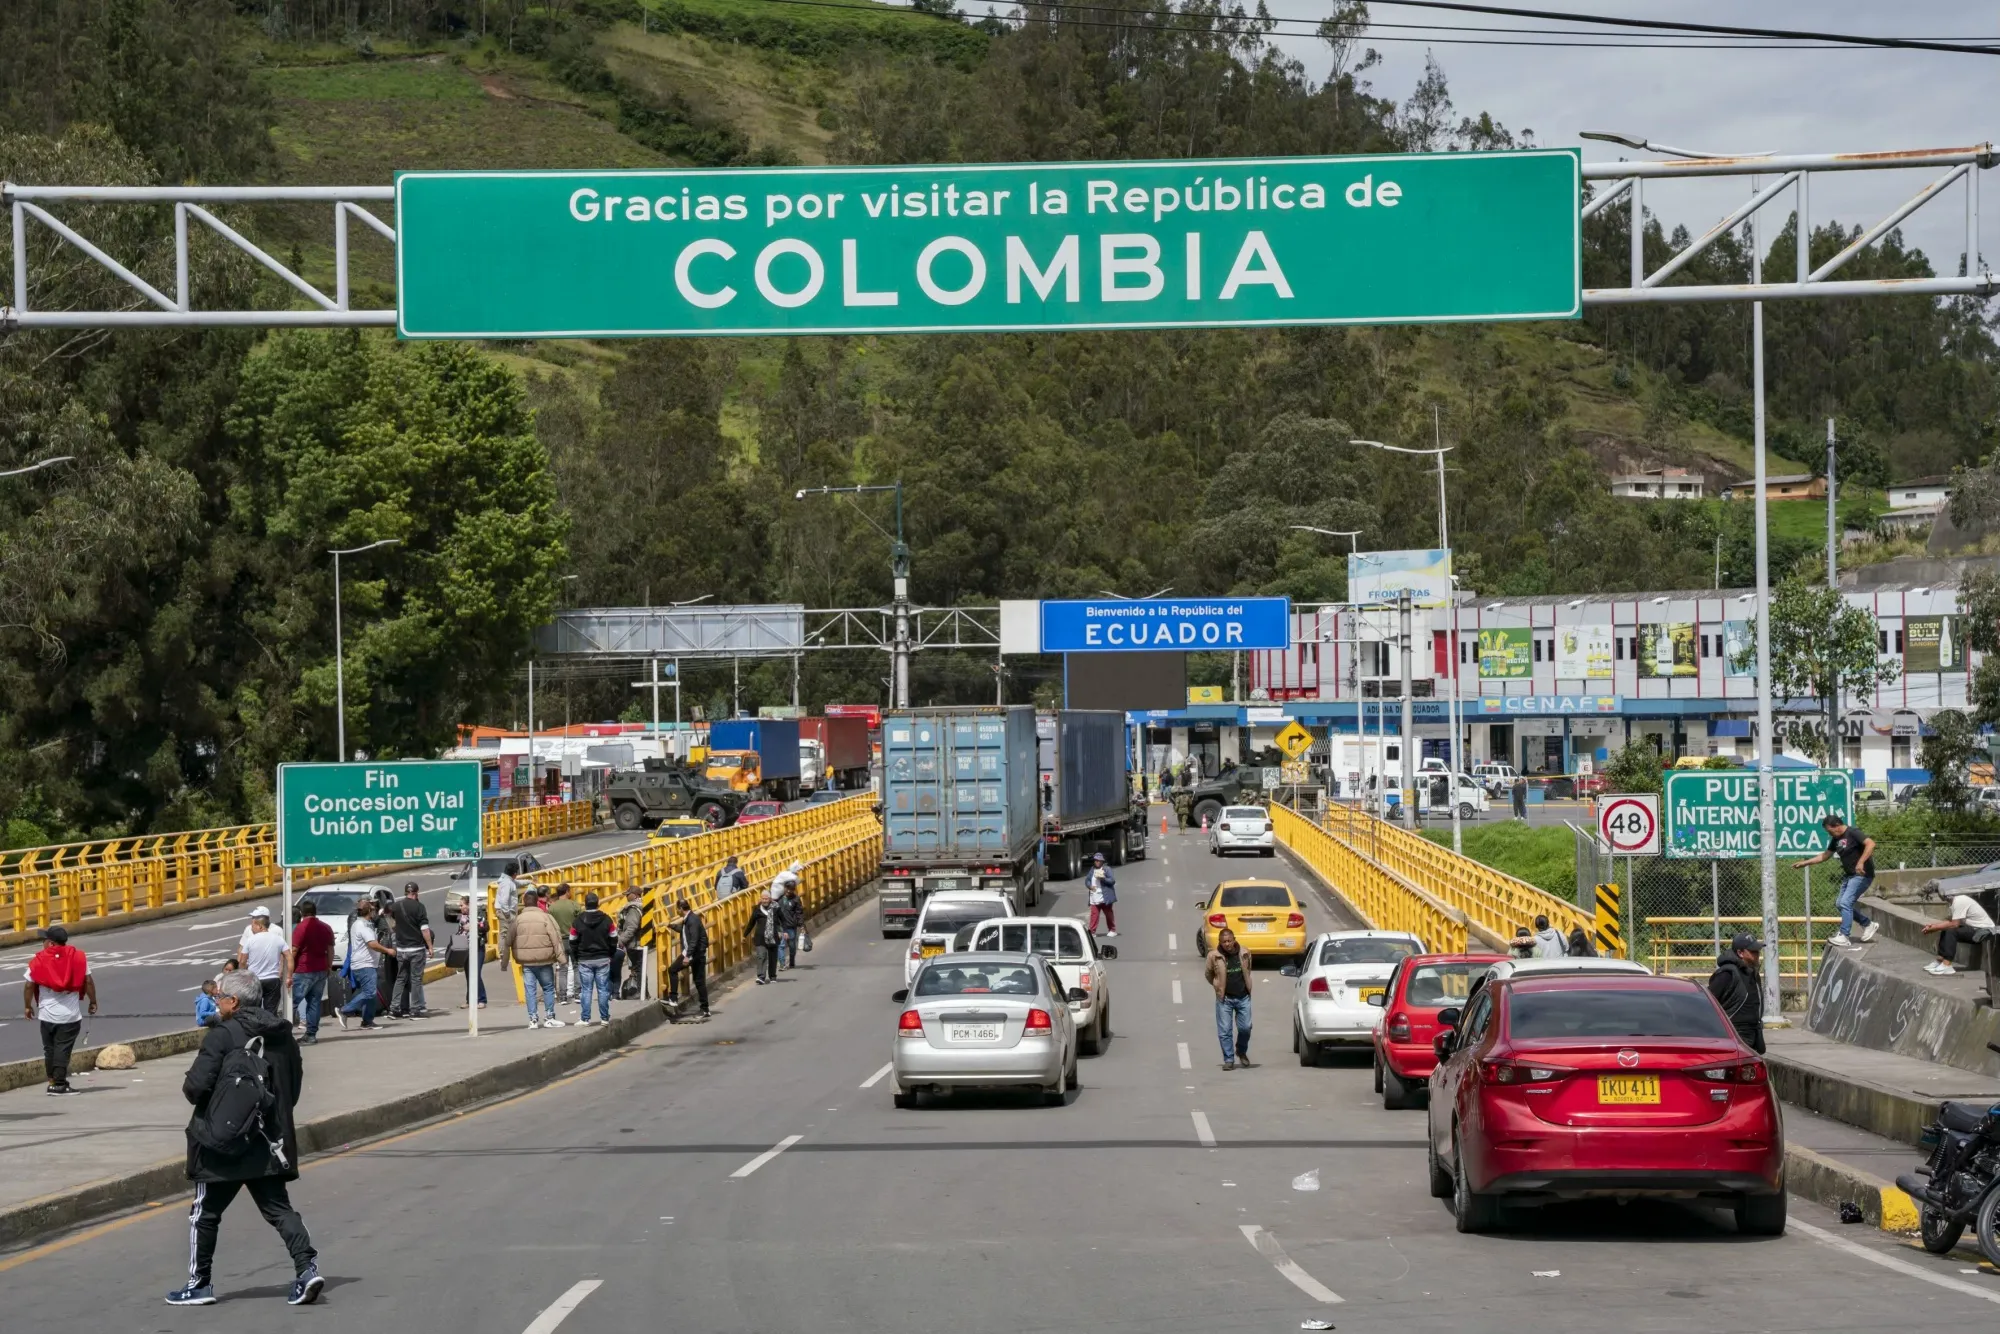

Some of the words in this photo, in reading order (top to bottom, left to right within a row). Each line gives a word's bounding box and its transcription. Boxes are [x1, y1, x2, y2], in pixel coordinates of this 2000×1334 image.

[568, 187, 747, 221] Gracias
[765, 191, 844, 228] por
[861, 183, 1011, 218] visitar
[1028, 182, 1067, 215] la
[1087, 175, 1326, 223] República
[1345, 173, 1402, 209] de
[674, 230, 1295, 309] COLOMBIA
[1368, 589, 1430, 598] FRONTRAS
[1086, 606, 1146, 617] Bienvenido
[1158, 606, 1168, 616] la
[1171, 605, 1224, 618] República
[1227, 605, 1243, 615] del
[1086, 622, 1243, 645] ECUADOR
[1909, 629, 1939, 638] BULL
[1412, 704, 1440, 714] CUADOR
[1505, 696, 1593, 711] CENAF
[1749, 716, 1864, 737] MGRACÓN
[365, 769, 399, 789] Fin
[1705, 777, 1811, 802] PUETE
[304, 793, 419, 813] Concesion
[425, 791, 464, 809] Vial
[310, 815, 372, 836] Unión
[380, 814, 414, 834] Del
[421, 813, 458, 832] Sur
[1676, 804, 1835, 825] INTERNAIONA
[1697, 830, 1823, 850] RUMICACA
[1601, 1079, 1627, 1096] IKU
[1631, 1079, 1657, 1096] 411
